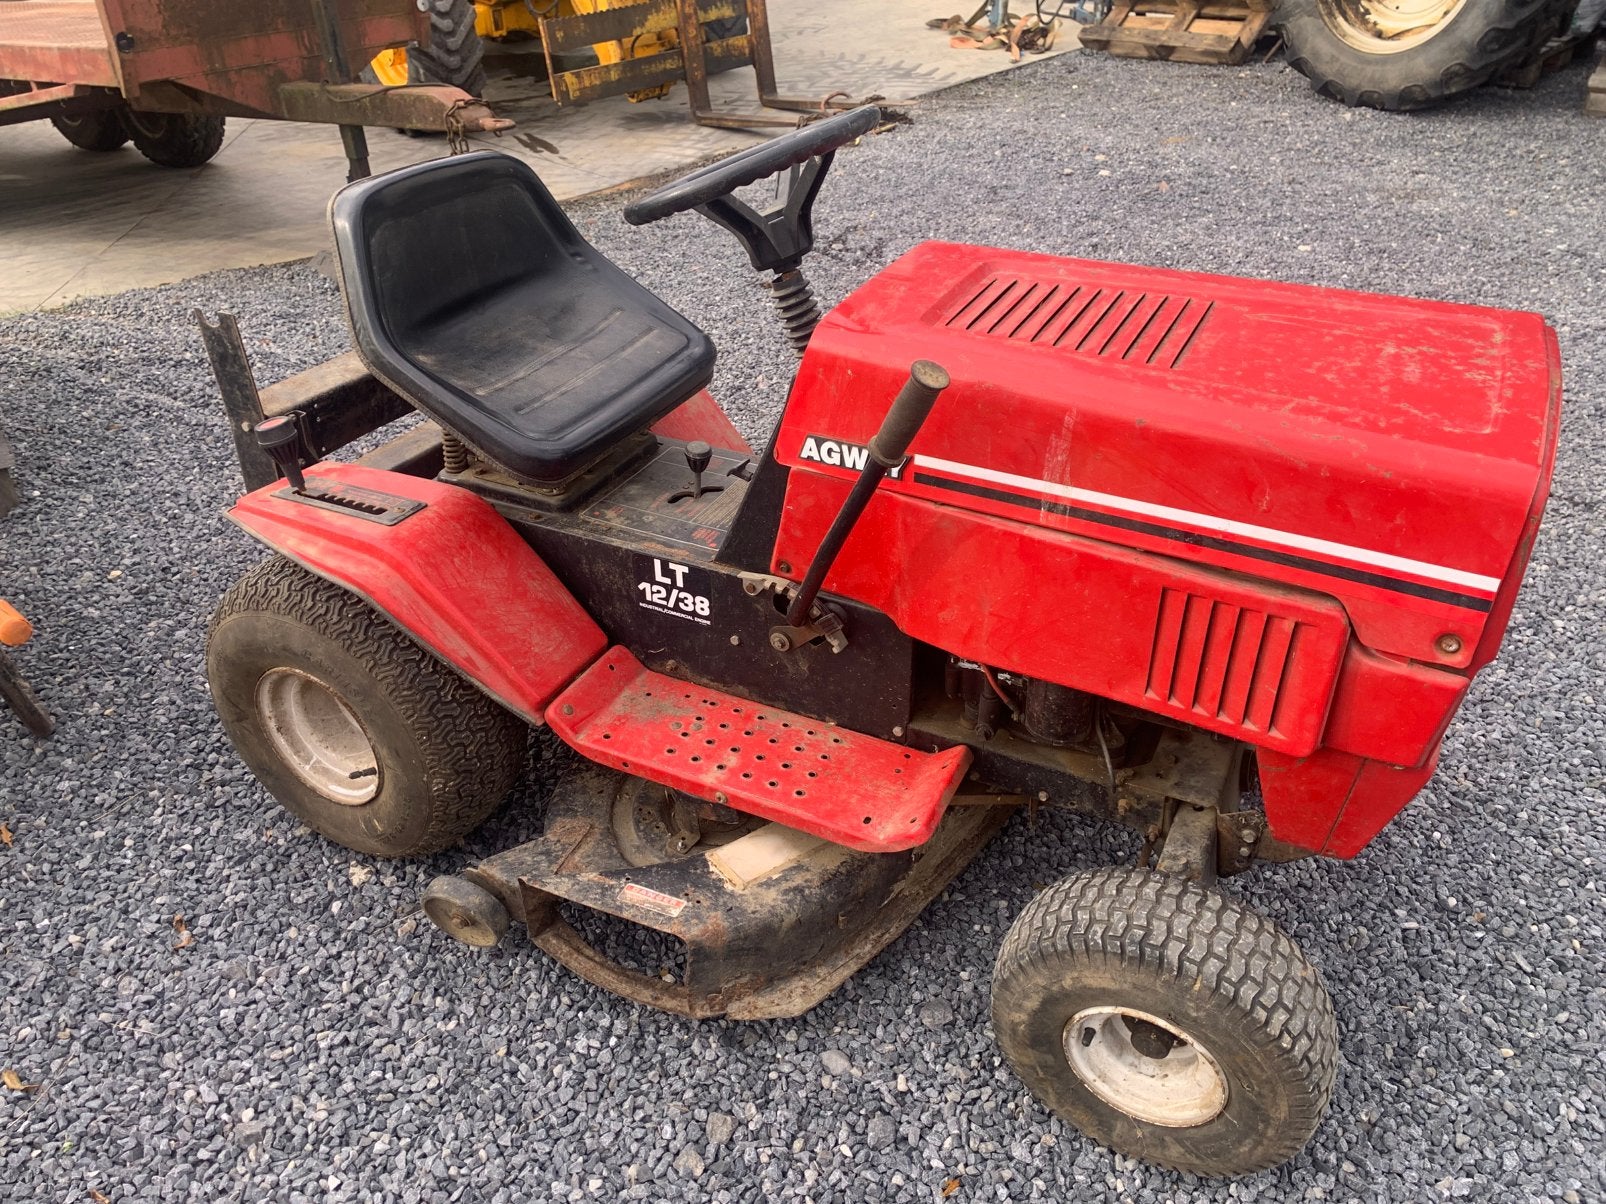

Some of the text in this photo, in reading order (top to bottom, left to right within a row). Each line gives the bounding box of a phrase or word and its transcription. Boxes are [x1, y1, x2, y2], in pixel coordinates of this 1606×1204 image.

[800, 437, 907, 478] AGWY
[653, 558, 689, 588] LT
[637, 581, 710, 616] 12/38
